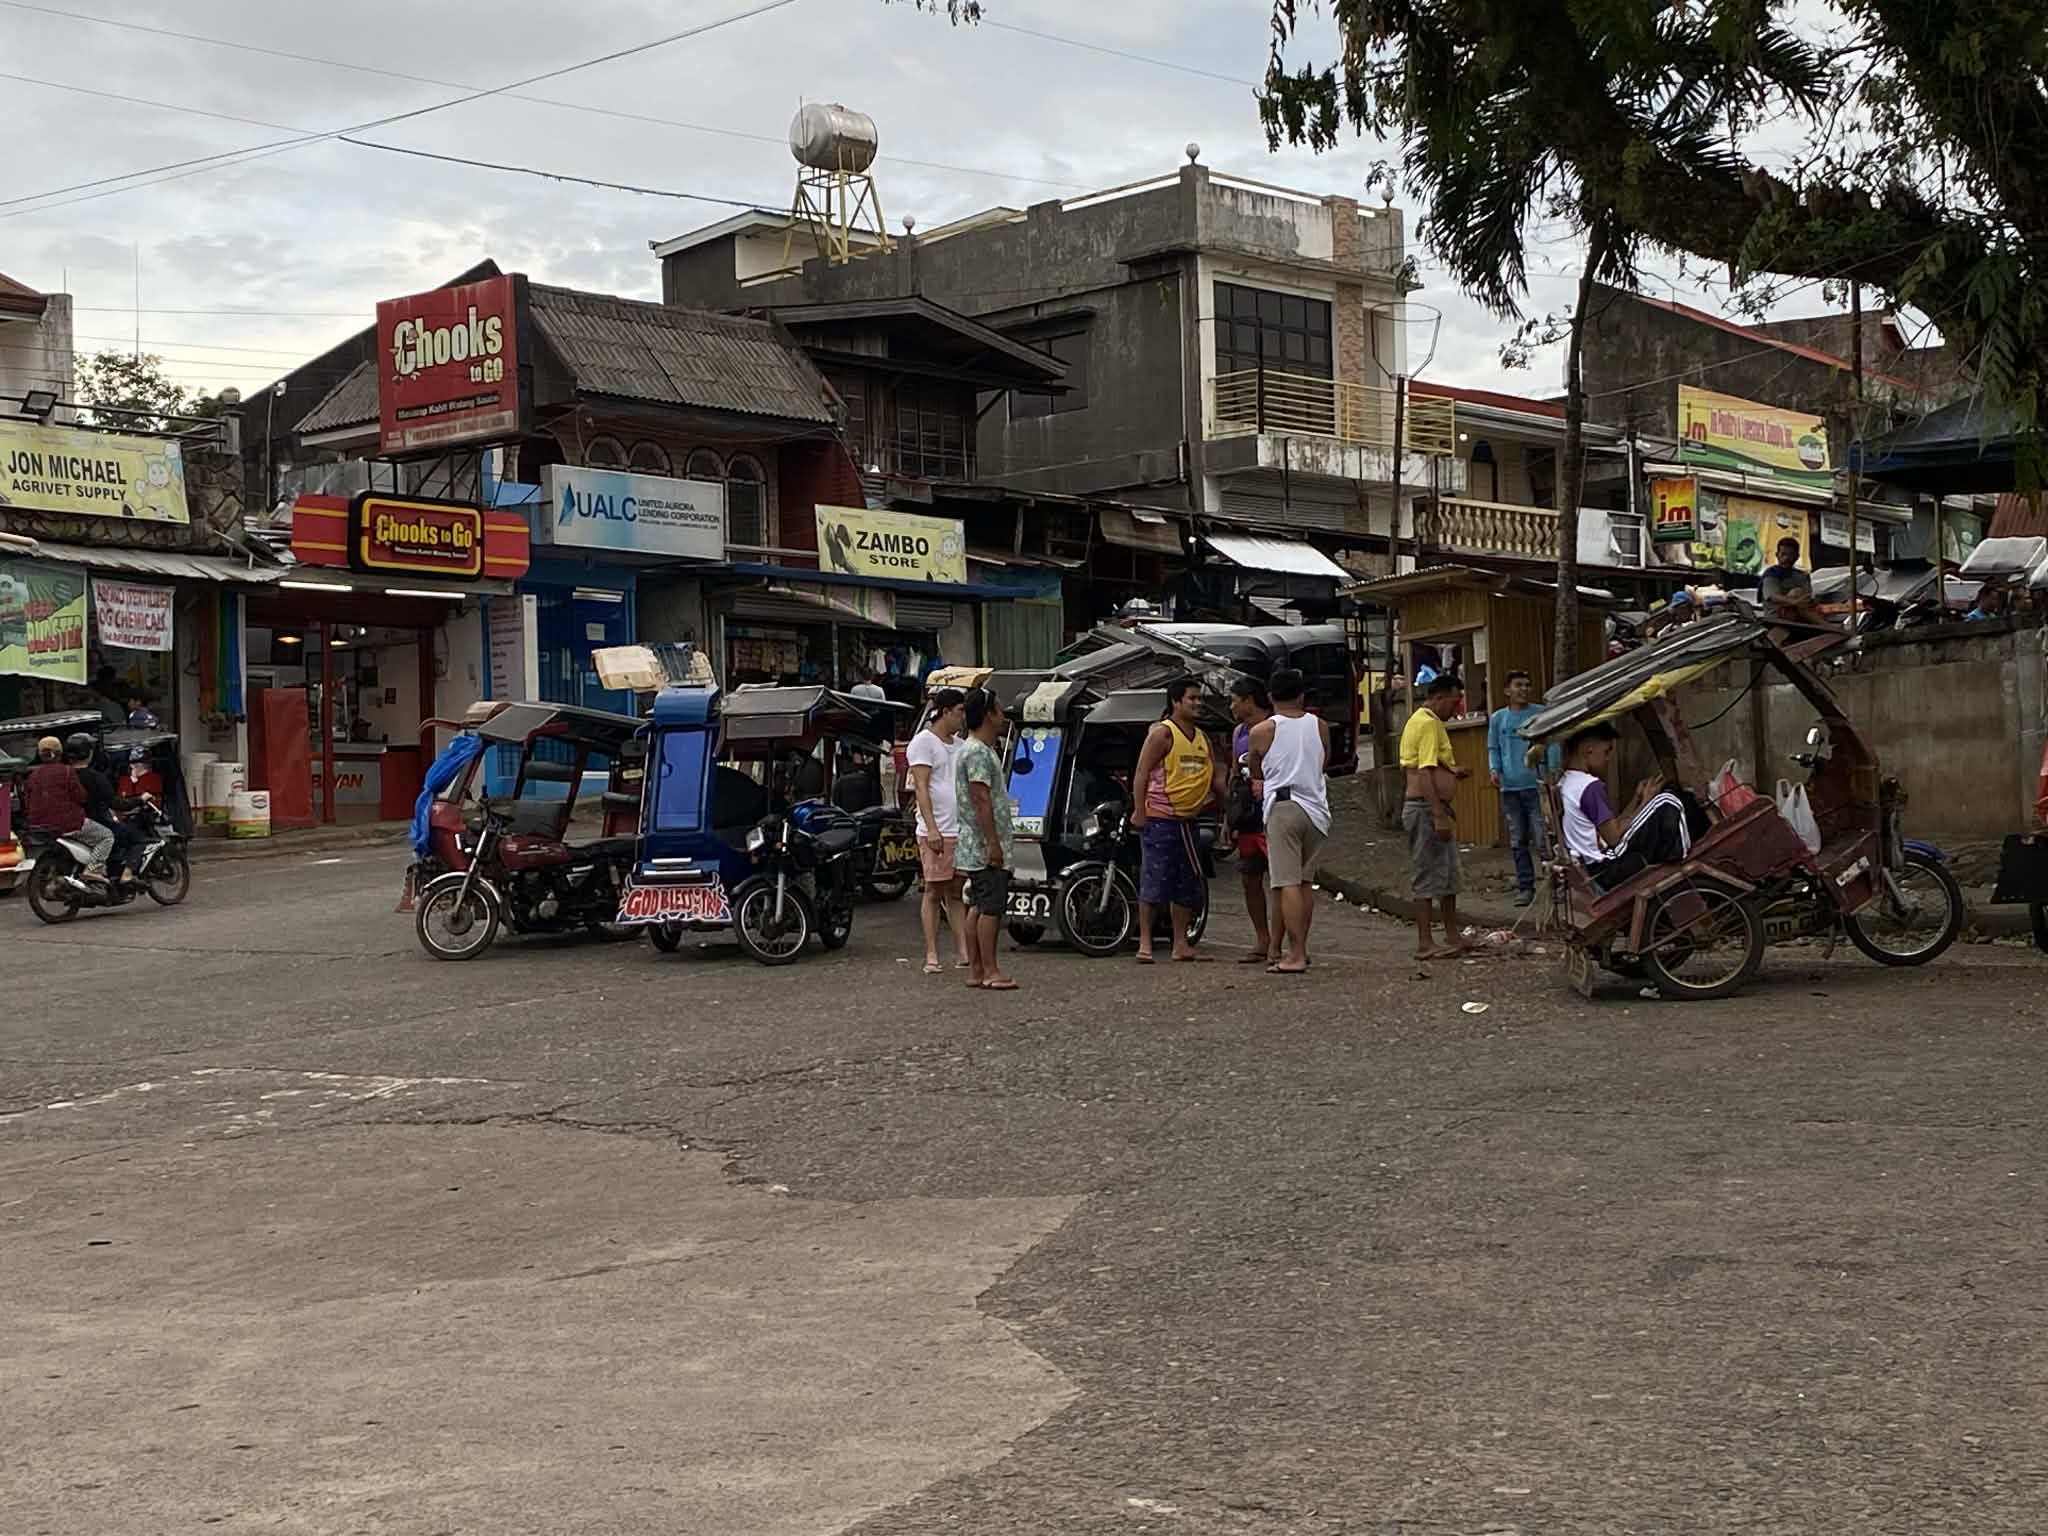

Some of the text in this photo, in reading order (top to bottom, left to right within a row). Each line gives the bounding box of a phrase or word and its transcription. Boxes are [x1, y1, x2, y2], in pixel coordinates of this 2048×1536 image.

[394, 305, 503, 375] Chooks
[470, 365, 483, 382] to
[8, 450, 127, 485] JON MICHAEL
[12, 479, 126, 501] AGRIVET SUPPLY
[576, 491, 696, 522] UALC UNITED AURORA
[638, 508, 721, 524] LENDING CORPORATION
[1656, 494, 1691, 522] jm
[376, 514, 438, 545] Chooks
[452, 522, 472, 547] Go
[856, 530, 929, 556] ZAMBO
[869, 554, 920, 569] STORE
[626, 888, 659, 916] GOD
[660, 888, 692, 911] BLESS
